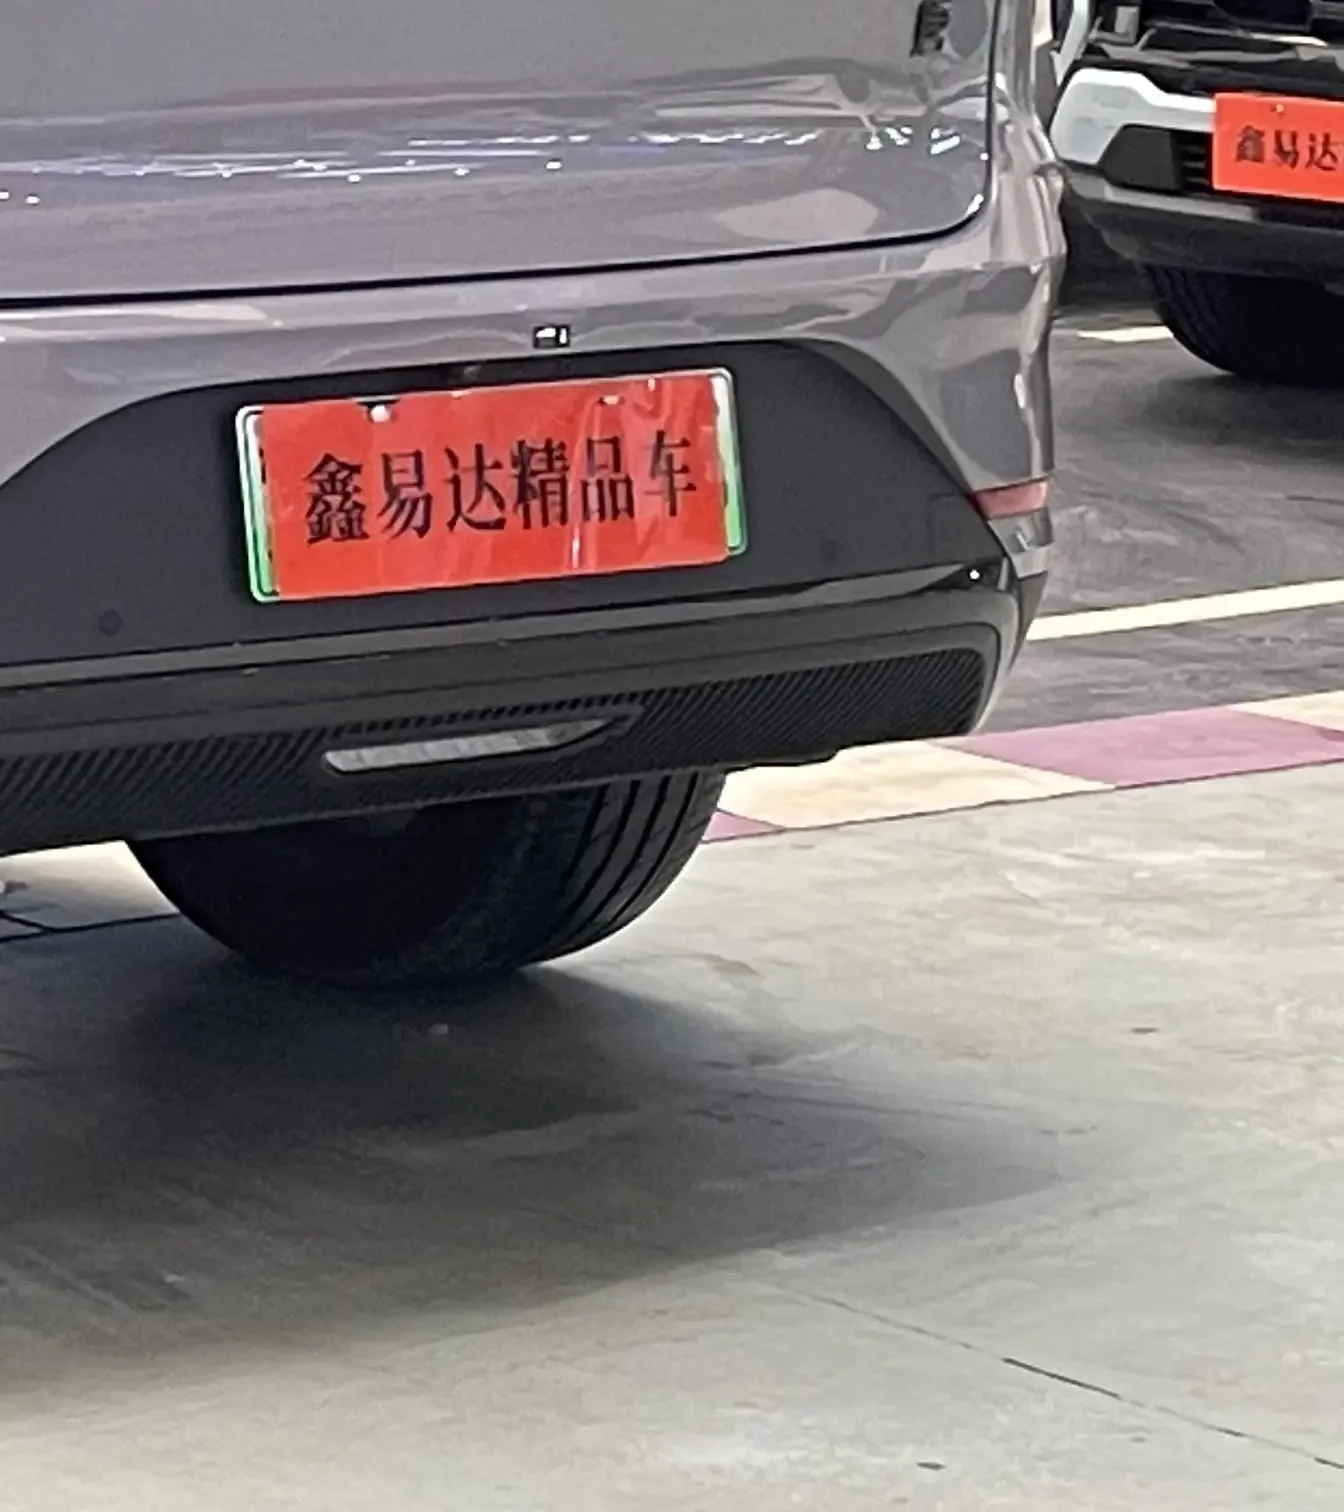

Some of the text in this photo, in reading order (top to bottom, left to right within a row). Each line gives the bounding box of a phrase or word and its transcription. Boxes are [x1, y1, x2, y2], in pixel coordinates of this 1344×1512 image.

[303, 429, 697, 545] 鑫易达精品车
